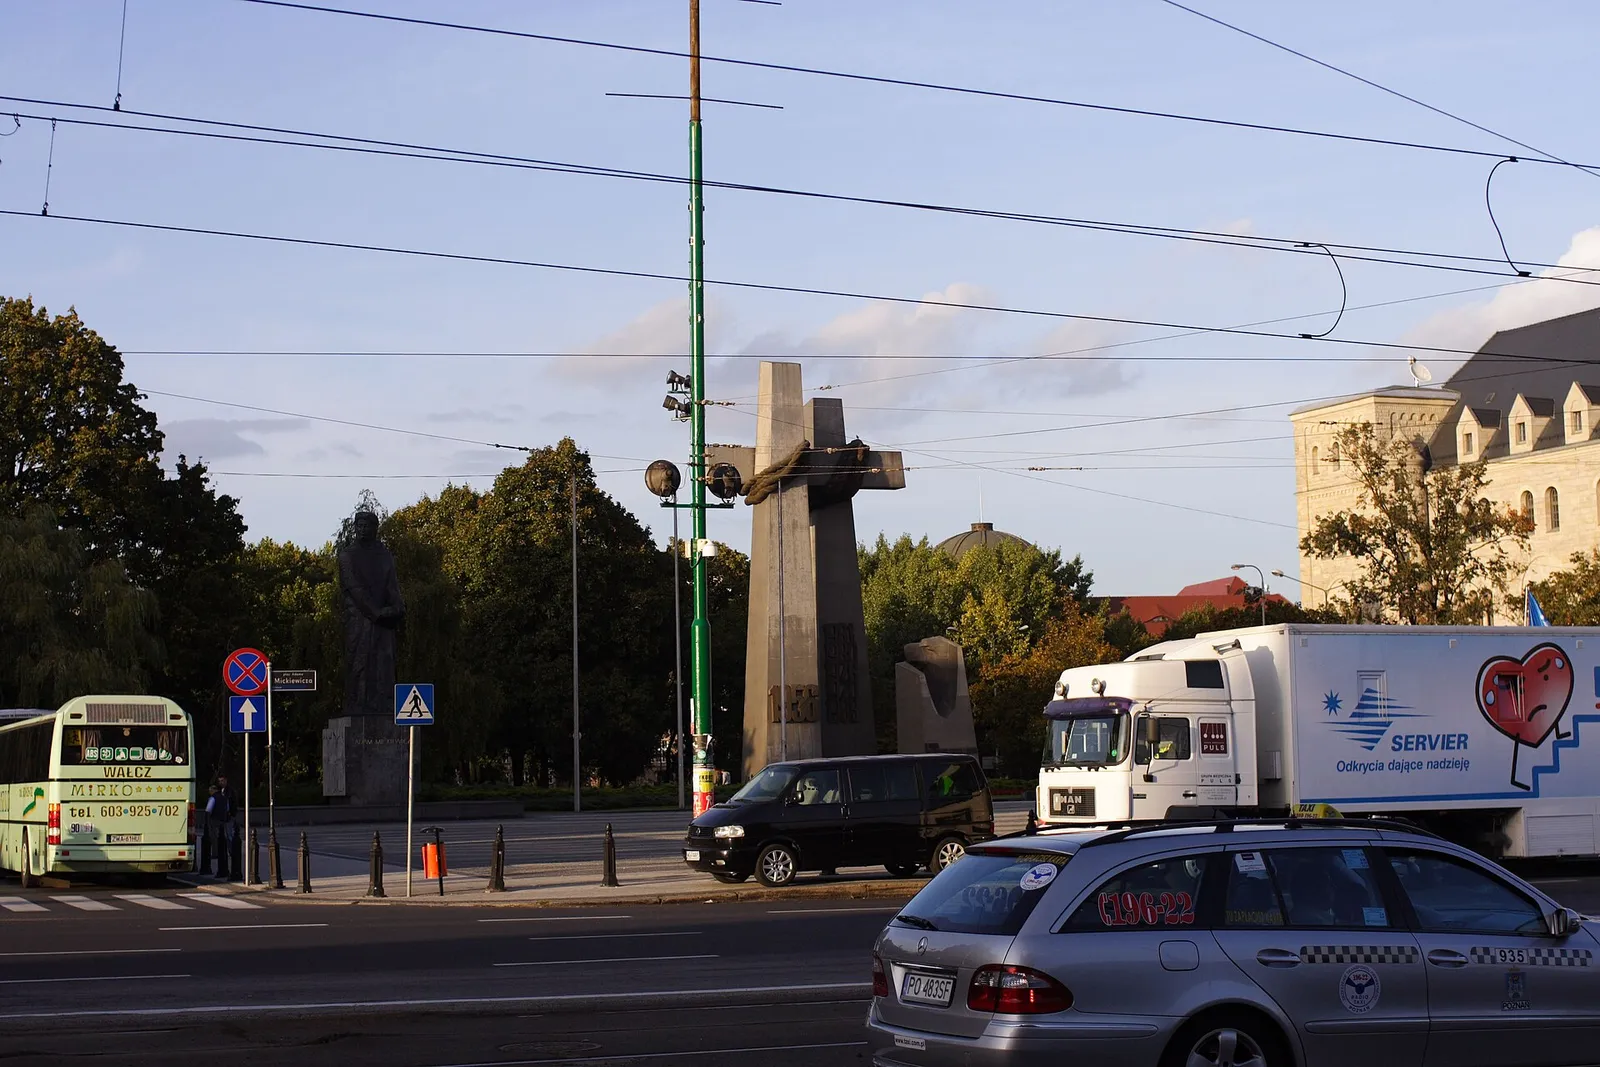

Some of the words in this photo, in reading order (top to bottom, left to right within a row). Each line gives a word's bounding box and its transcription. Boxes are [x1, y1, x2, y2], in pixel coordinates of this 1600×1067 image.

[274, 677, 313, 685] Mickiewicza
[1391, 733, 1469, 752] SERVIER
[86, 749, 98, 758] ABS
[1336, 759, 1384, 775] Odkrycia
[1388, 758, 1423, 774] dające
[1426, 756, 1470, 772] nadzieję
[103, 766, 152, 778] WAŁCZ
[1060, 795, 1082, 804] MAN
[69, 806, 95, 818] tel.
[1298, 804, 1316, 812] TAXI
[1108, 892, 1195, 925] 196-22
[1499, 949, 1524, 962] 935
[907, 976, 922, 995] PO
[923, 978, 951, 999] 483SF
